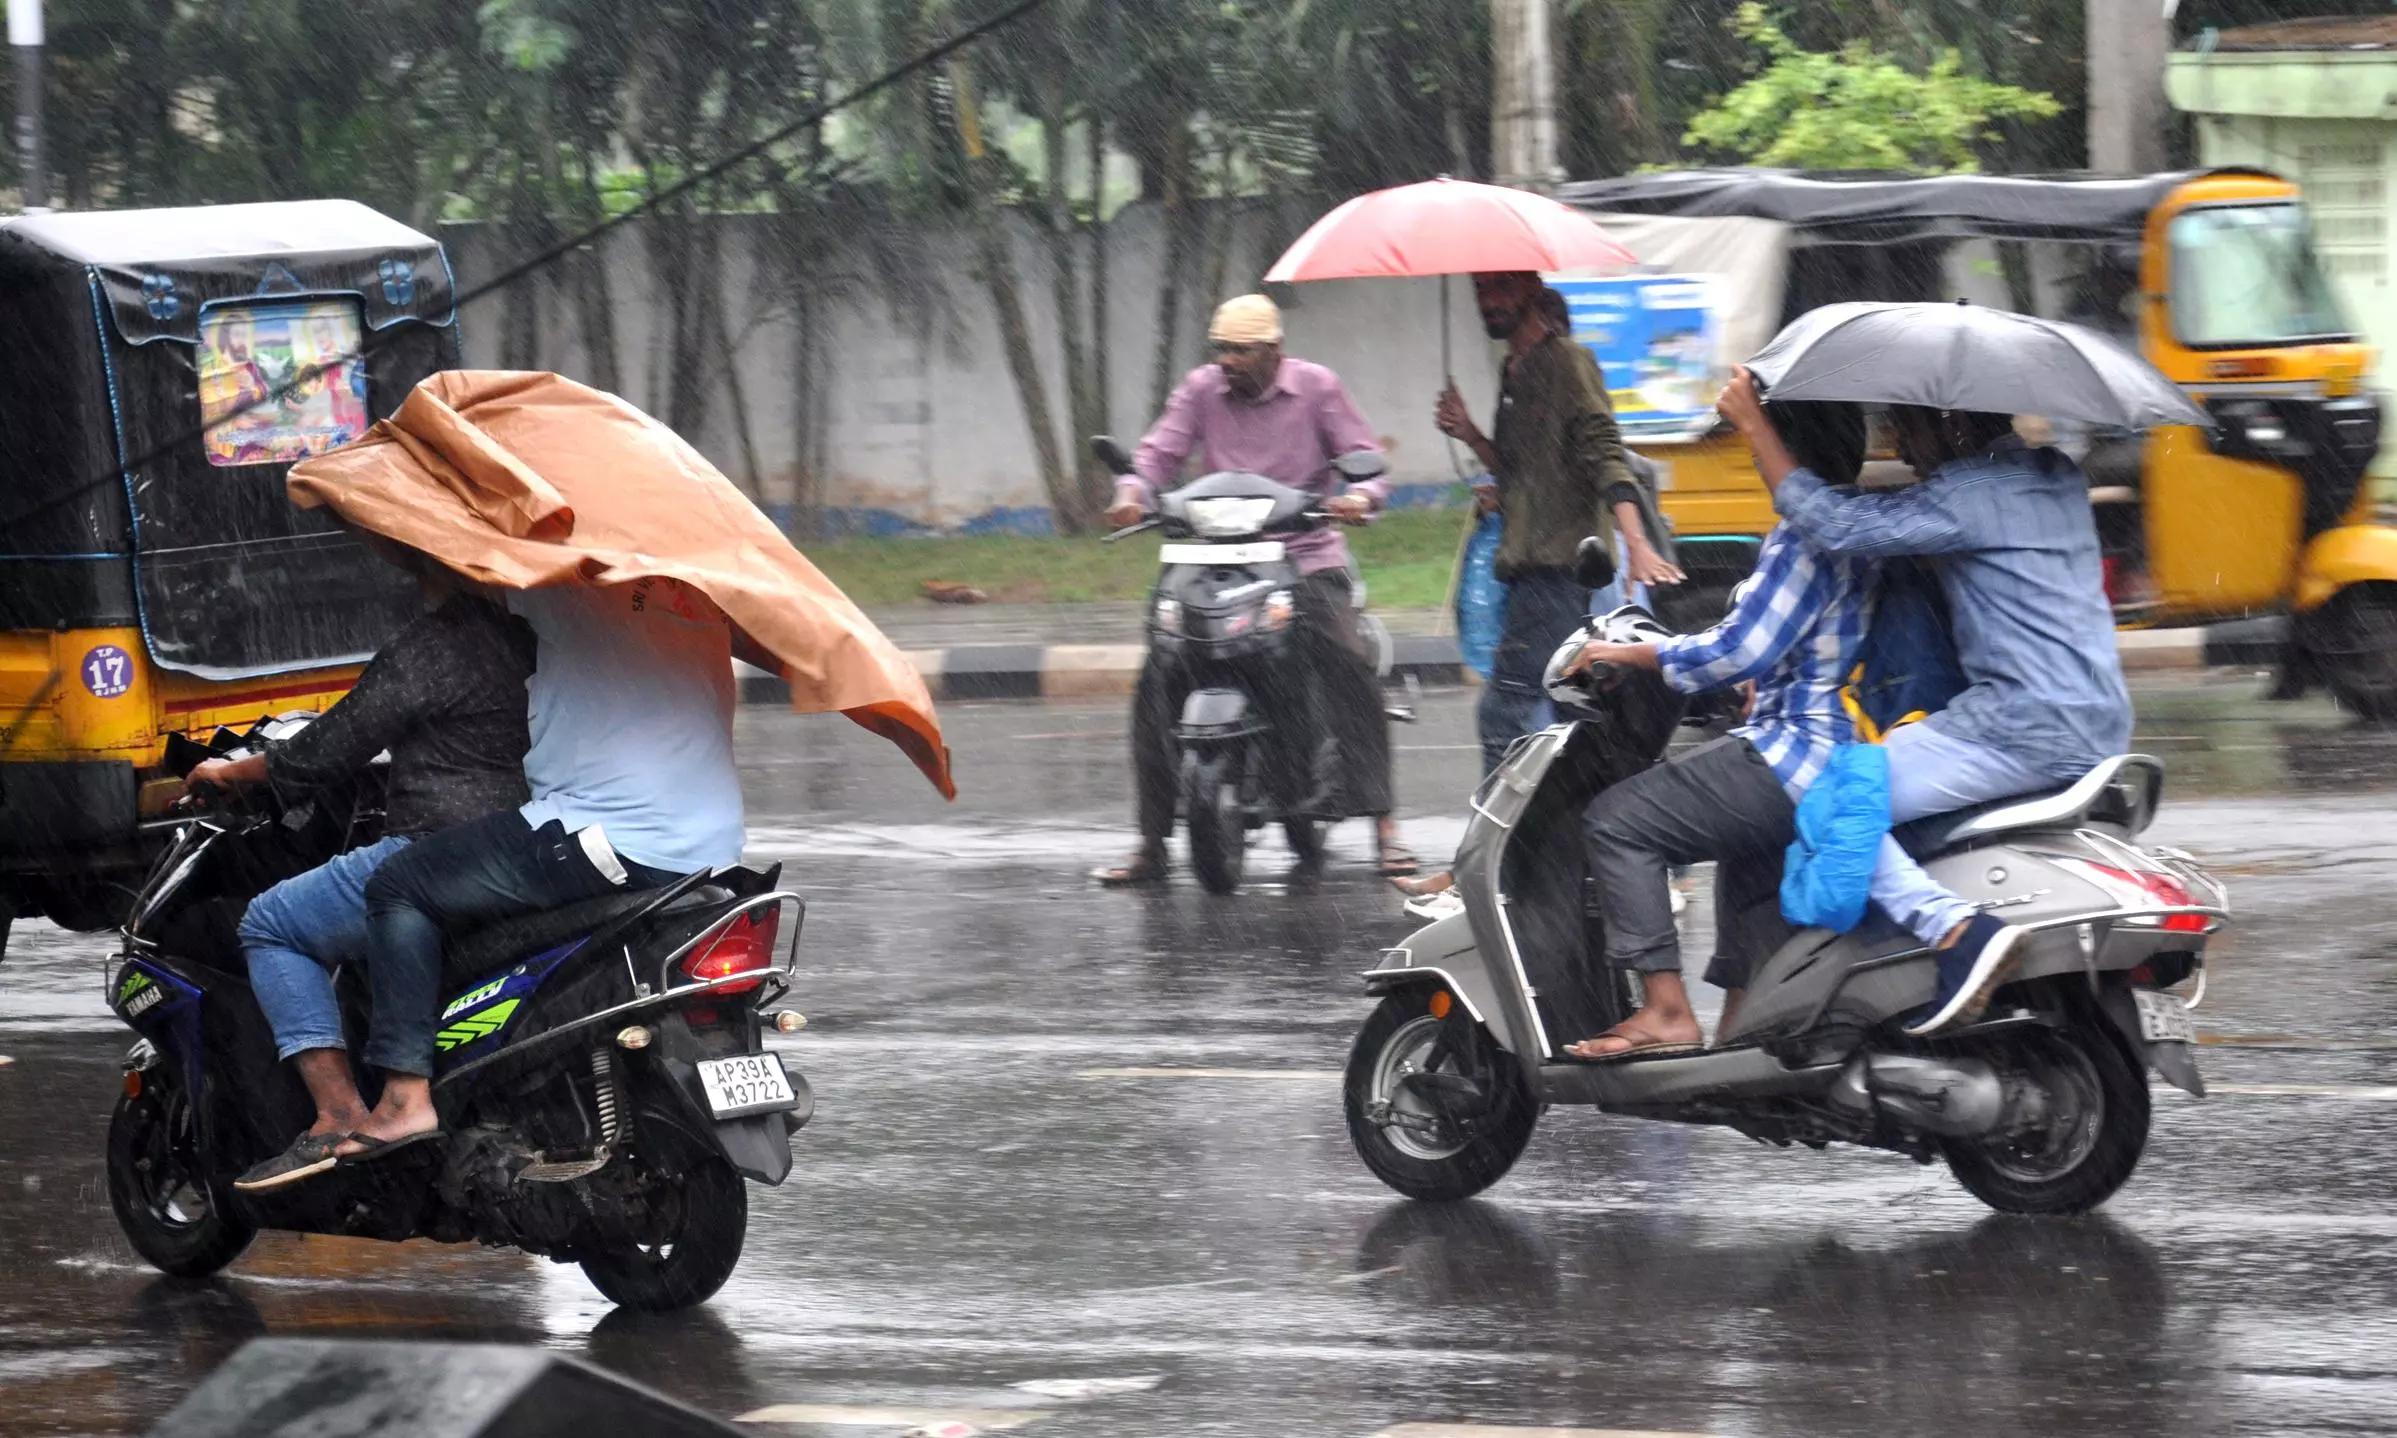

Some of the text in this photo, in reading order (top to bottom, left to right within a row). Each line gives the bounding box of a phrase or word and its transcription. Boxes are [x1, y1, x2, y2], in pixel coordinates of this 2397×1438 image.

[631, 588, 646, 612] SRI
[88, 655, 124, 690] 17
[125, 985, 163, 1017] YAMAHA
[714, 1058, 773, 1084] AP39A
[722, 1079, 785, 1107] M3722
